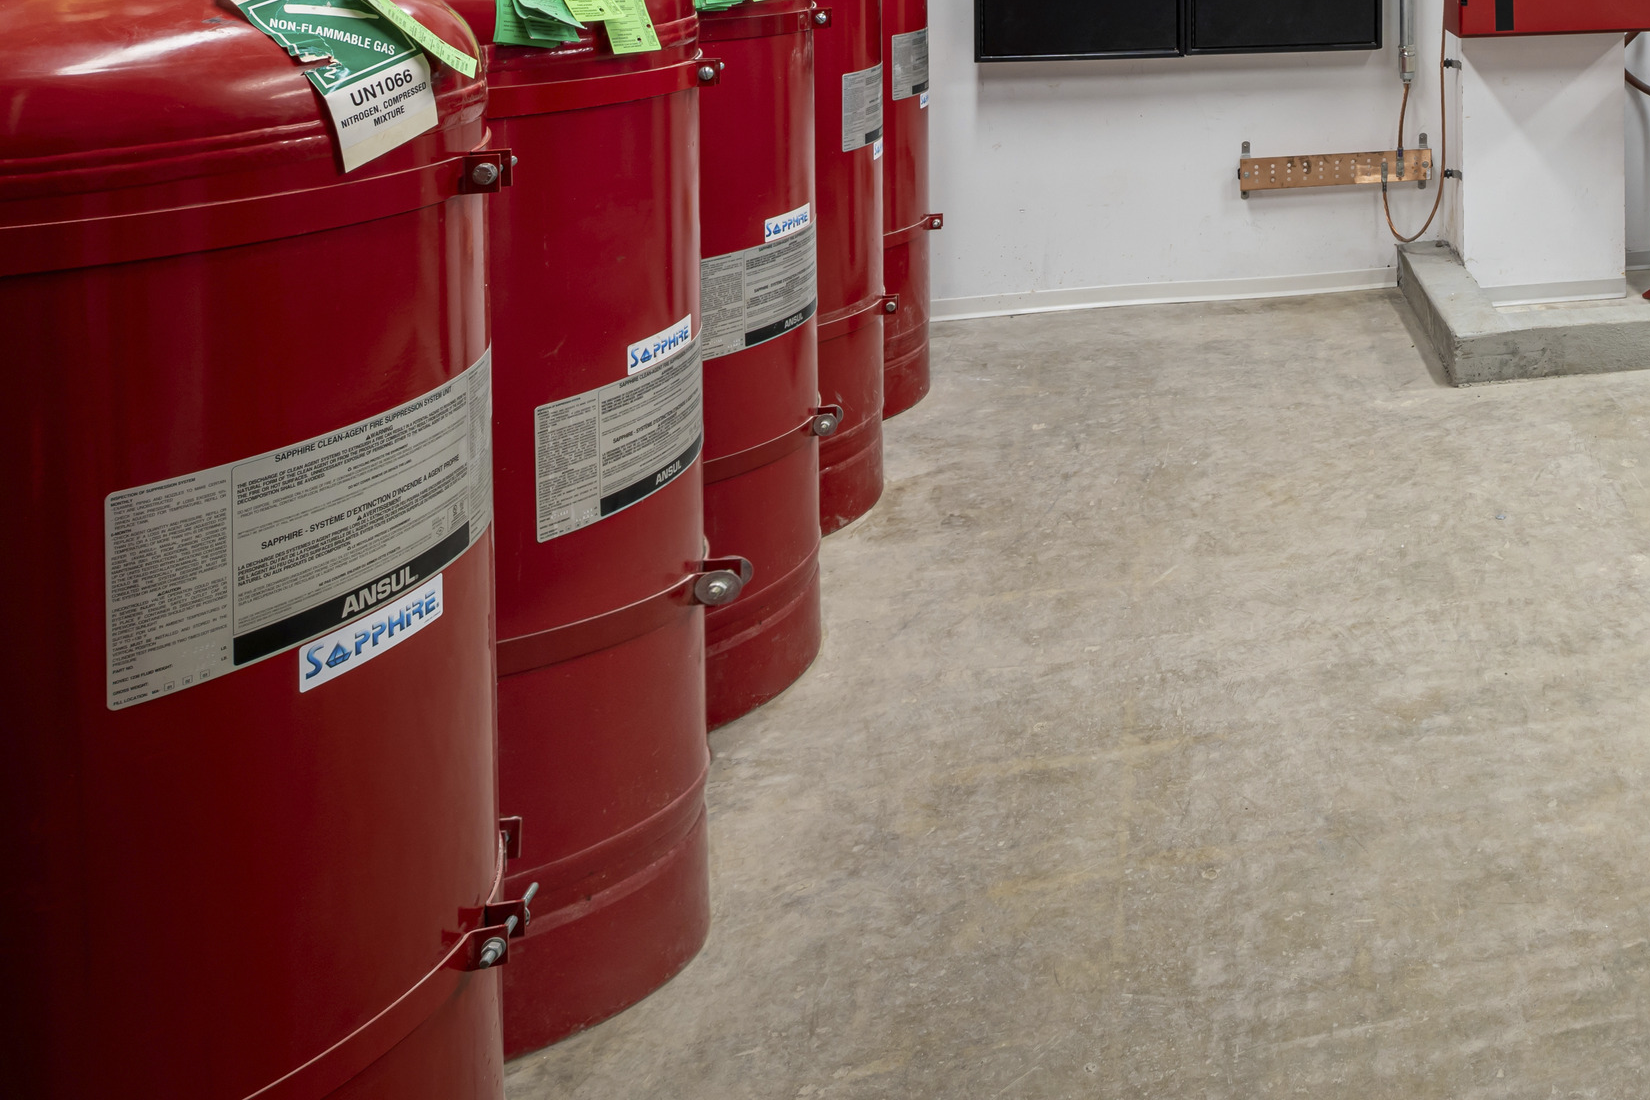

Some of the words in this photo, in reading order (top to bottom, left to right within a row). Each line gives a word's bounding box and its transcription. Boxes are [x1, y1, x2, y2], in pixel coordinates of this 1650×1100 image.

[270, 18, 371, 49] NON-FLAMMABLE
[374, 41, 395, 55] GAS
[350, 69, 413, 107] UN1066
[341, 105, 382, 129] NITROGEN,
[383, 82, 427, 109] COMPRESSED
[374, 106, 405, 127] MIXTURE
[784, 313, 803, 329] ANSUL
[275, 442, 315, 462] SAPPHIRE
[317, 422, 367, 449] CLEAN-AGENT
[369, 417, 384, 430] FIRE
[385, 399, 423, 424] SUPPRESSION
[424, 390, 441, 406] SYSTEM
[443, 385, 451, 396] UNIT
[370, 424, 393, 438] WARNING
[248, 472, 277, 486] DISCHARGE
[287, 464, 302, 473] CLEAN
[304, 458, 319, 468] AGENT
[656, 460, 681, 486] ANSUL
[237, 483, 260, 494] NATURAL
[261, 528, 302, 549] SAPPHIRE
[309, 511, 344, 532] SYSTÈME
[346, 492, 390, 517] D'EXTINCTION
[428, 464, 443, 478] AGENT
[362, 496, 401, 518] AVERTISSEMENT
[342, 566, 414, 618] ANSUL
